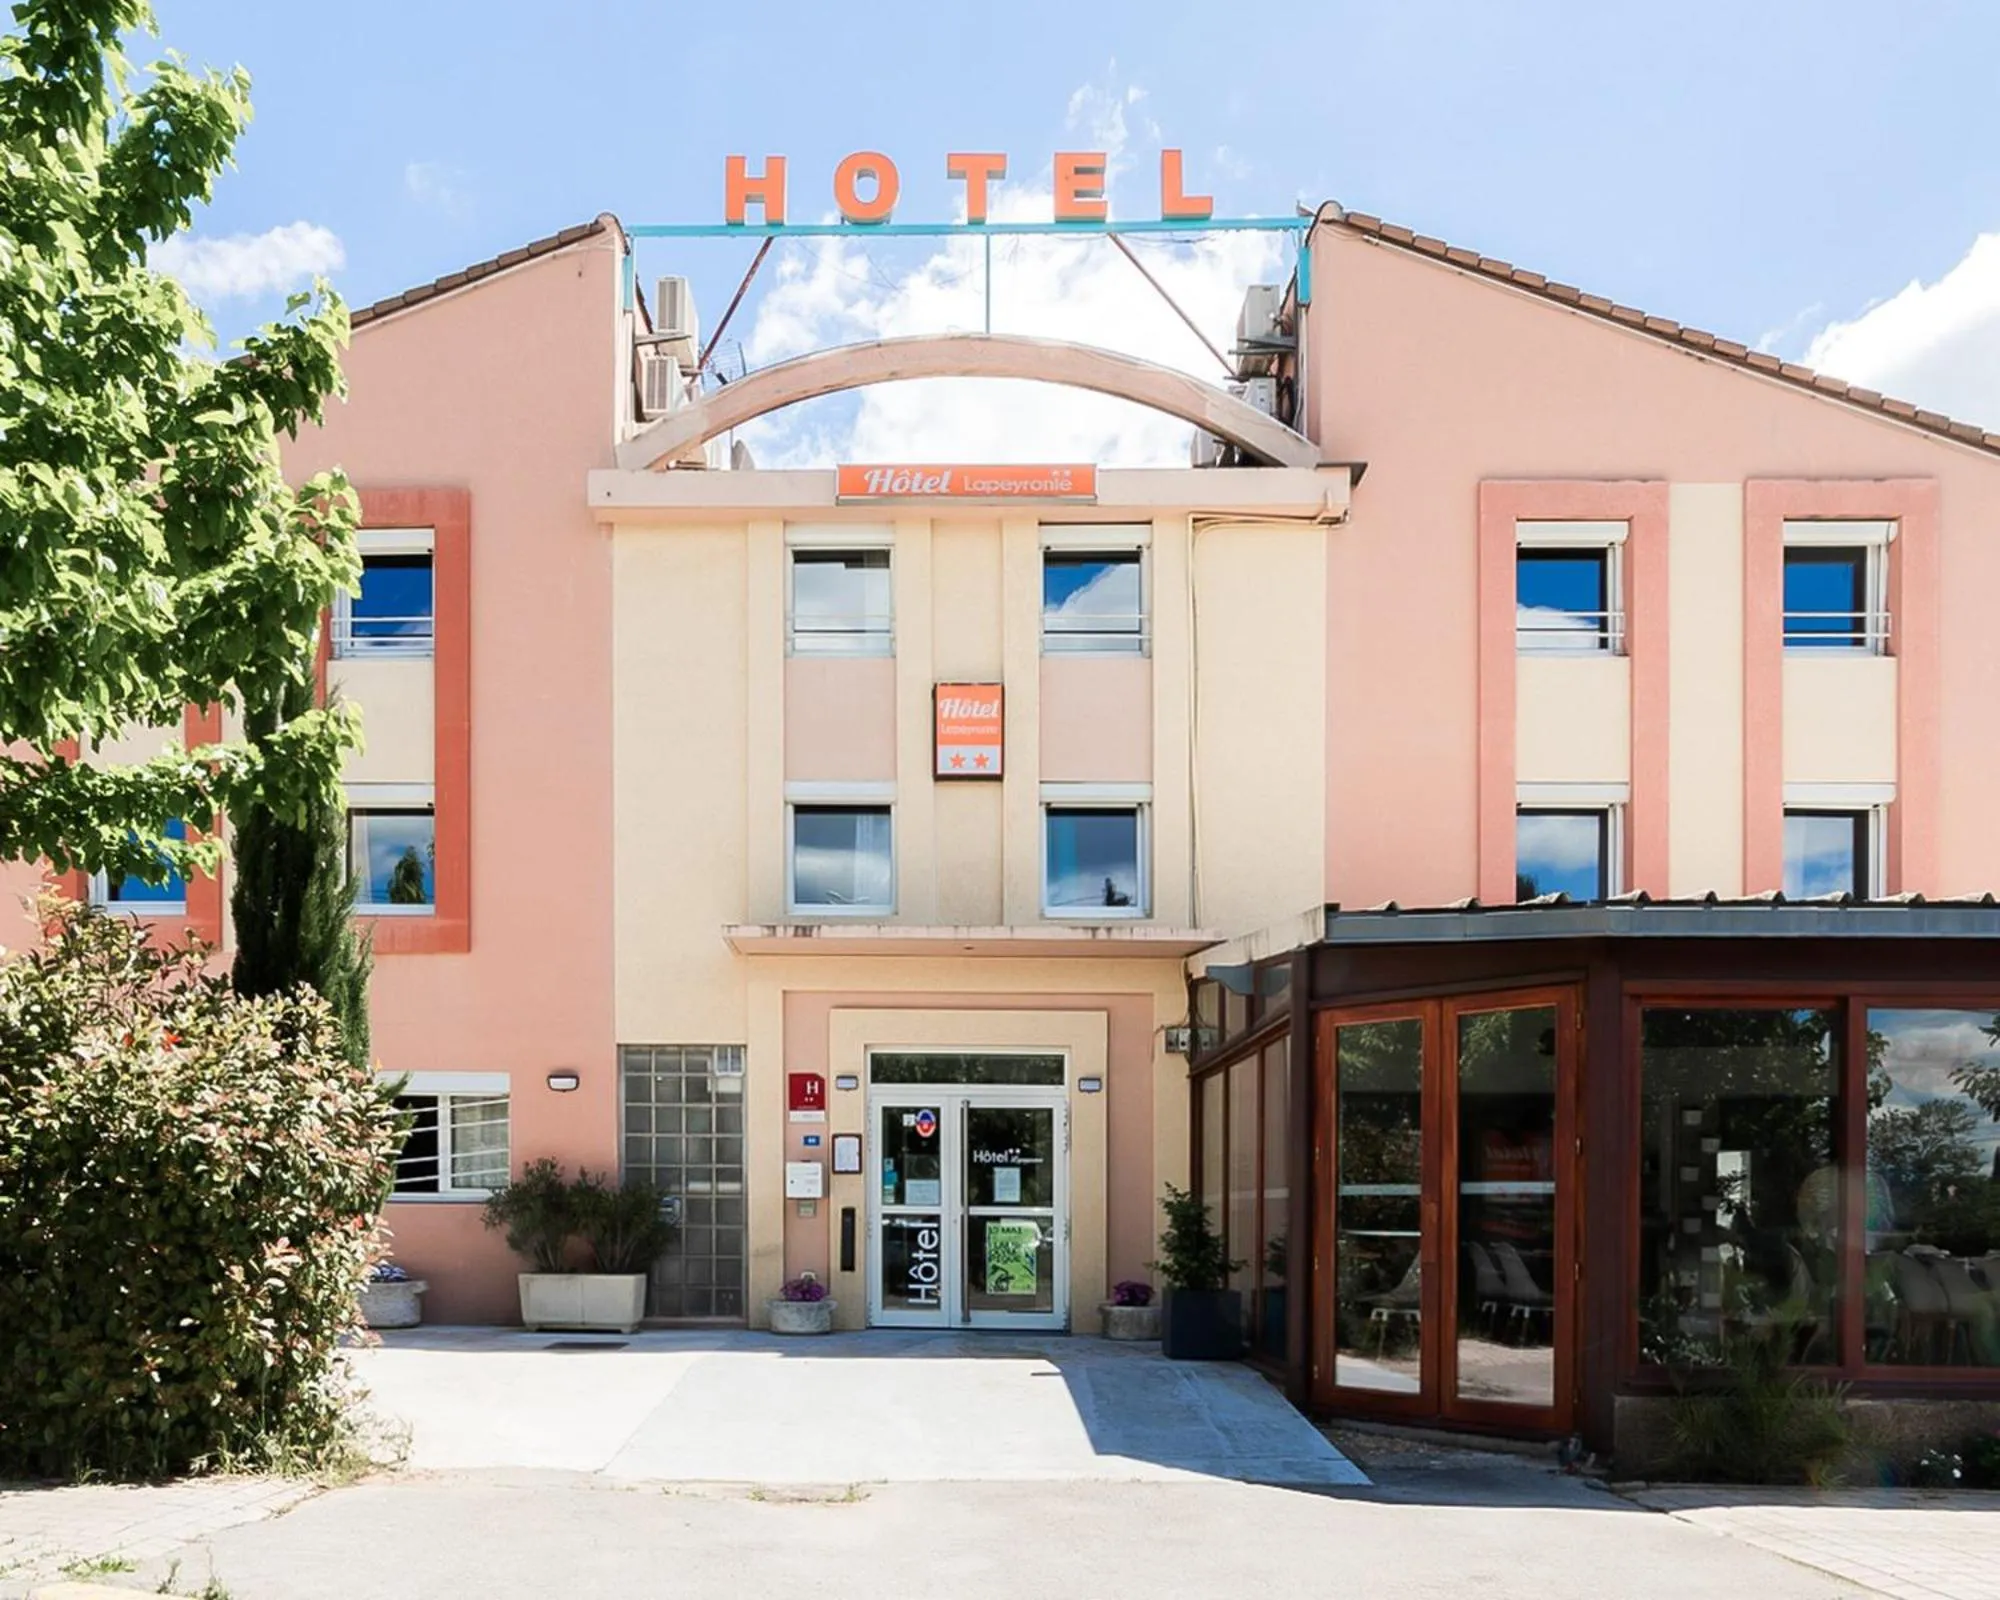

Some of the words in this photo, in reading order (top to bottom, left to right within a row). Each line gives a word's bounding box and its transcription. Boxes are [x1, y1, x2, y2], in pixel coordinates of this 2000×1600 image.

[725, 149, 1213, 224] HOTEL
[863, 468, 952, 494] Hôtel
[939, 697, 1000, 719] Hôtel
[806, 1080, 818, 1094] H
[972, 1149, 1008, 1163] Hôtel
[908, 1221, 938, 1304] Hôtel
